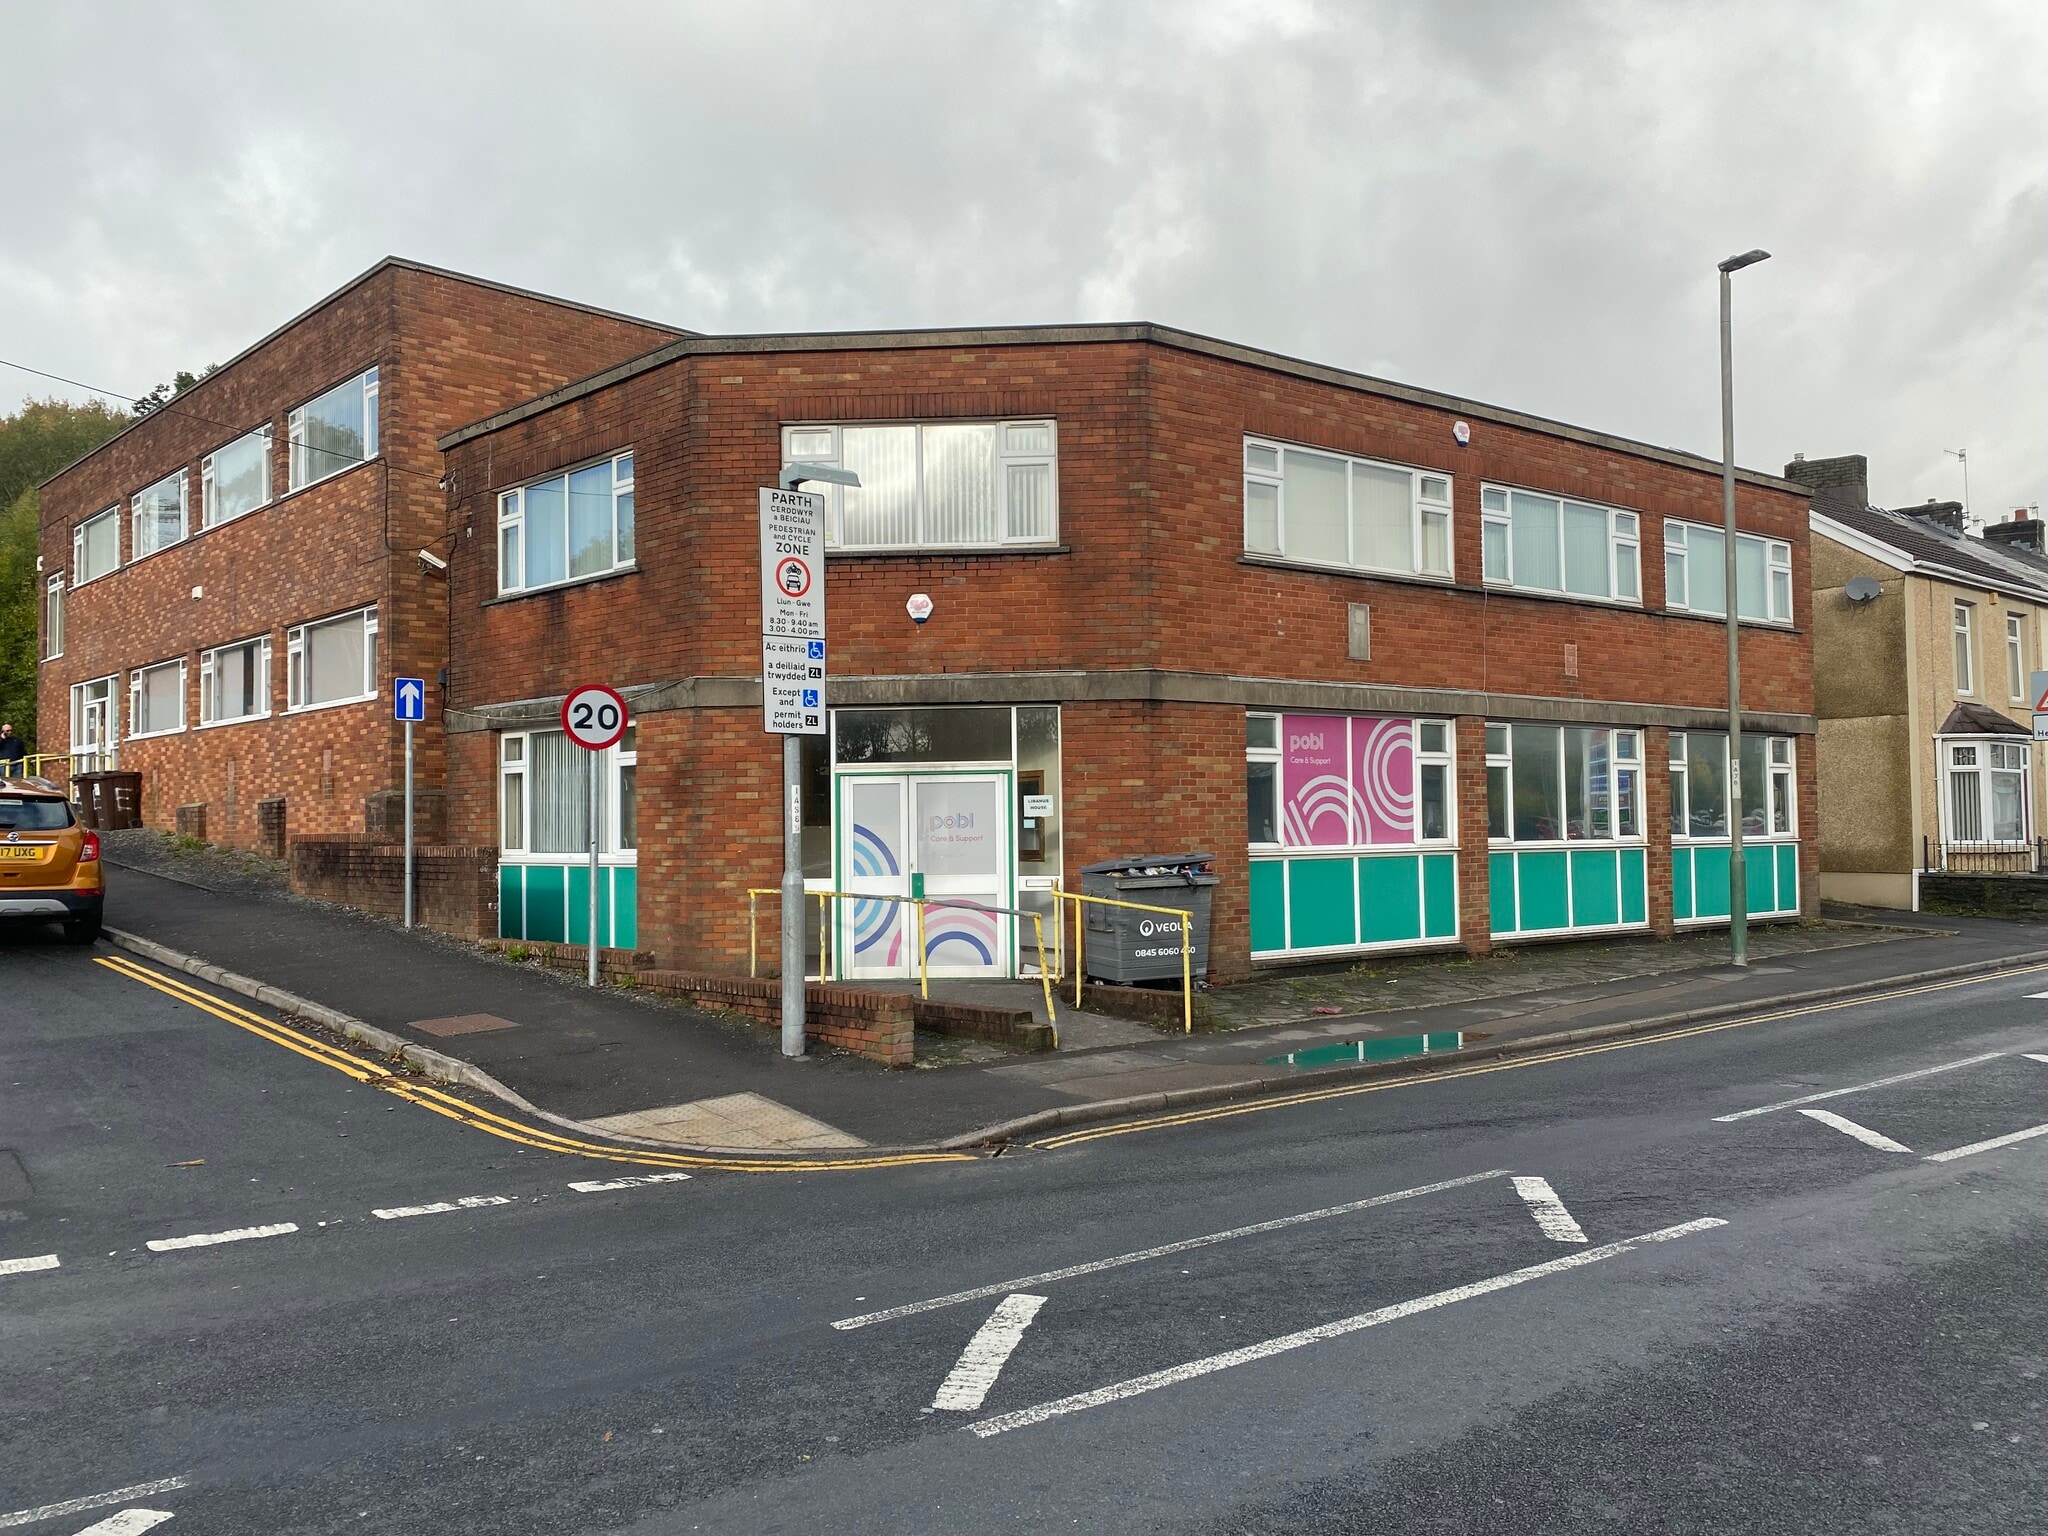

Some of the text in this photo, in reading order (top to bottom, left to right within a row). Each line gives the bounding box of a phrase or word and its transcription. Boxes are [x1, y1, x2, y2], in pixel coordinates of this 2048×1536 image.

[772, 492, 812, 507] PARTH
[770, 506, 813, 517] CERDDWYR
[780, 515, 811, 524] BEICIAU
[768, 524, 816, 536] PEDESTRIAN
[787, 534, 812, 543] CYCLE
[776, 542, 809, 555] ZONE
[765, 642, 806, 653] Ac eithrio
[776, 661, 805, 670] deiliaid
[768, 671, 806, 681] trwydded
[810, 669, 820, 677] ZL
[773, 687, 800, 697] Except
[573, 703, 619, 730] 20
[807, 716, 817, 725] ZL
[772, 720, 803, 729] holders
[1290, 732, 1324, 752] pobl
[1310, 757, 1330, 765] Support
[930, 812, 973, 832] pobl
[956, 835, 983, 843] Support
[14, 848, 36, 856] UXG
[1155, 921, 1193, 932] VEOLA
[1135, 948, 1156, 957] 0845
[1158, 947, 1179, 956] 6060
